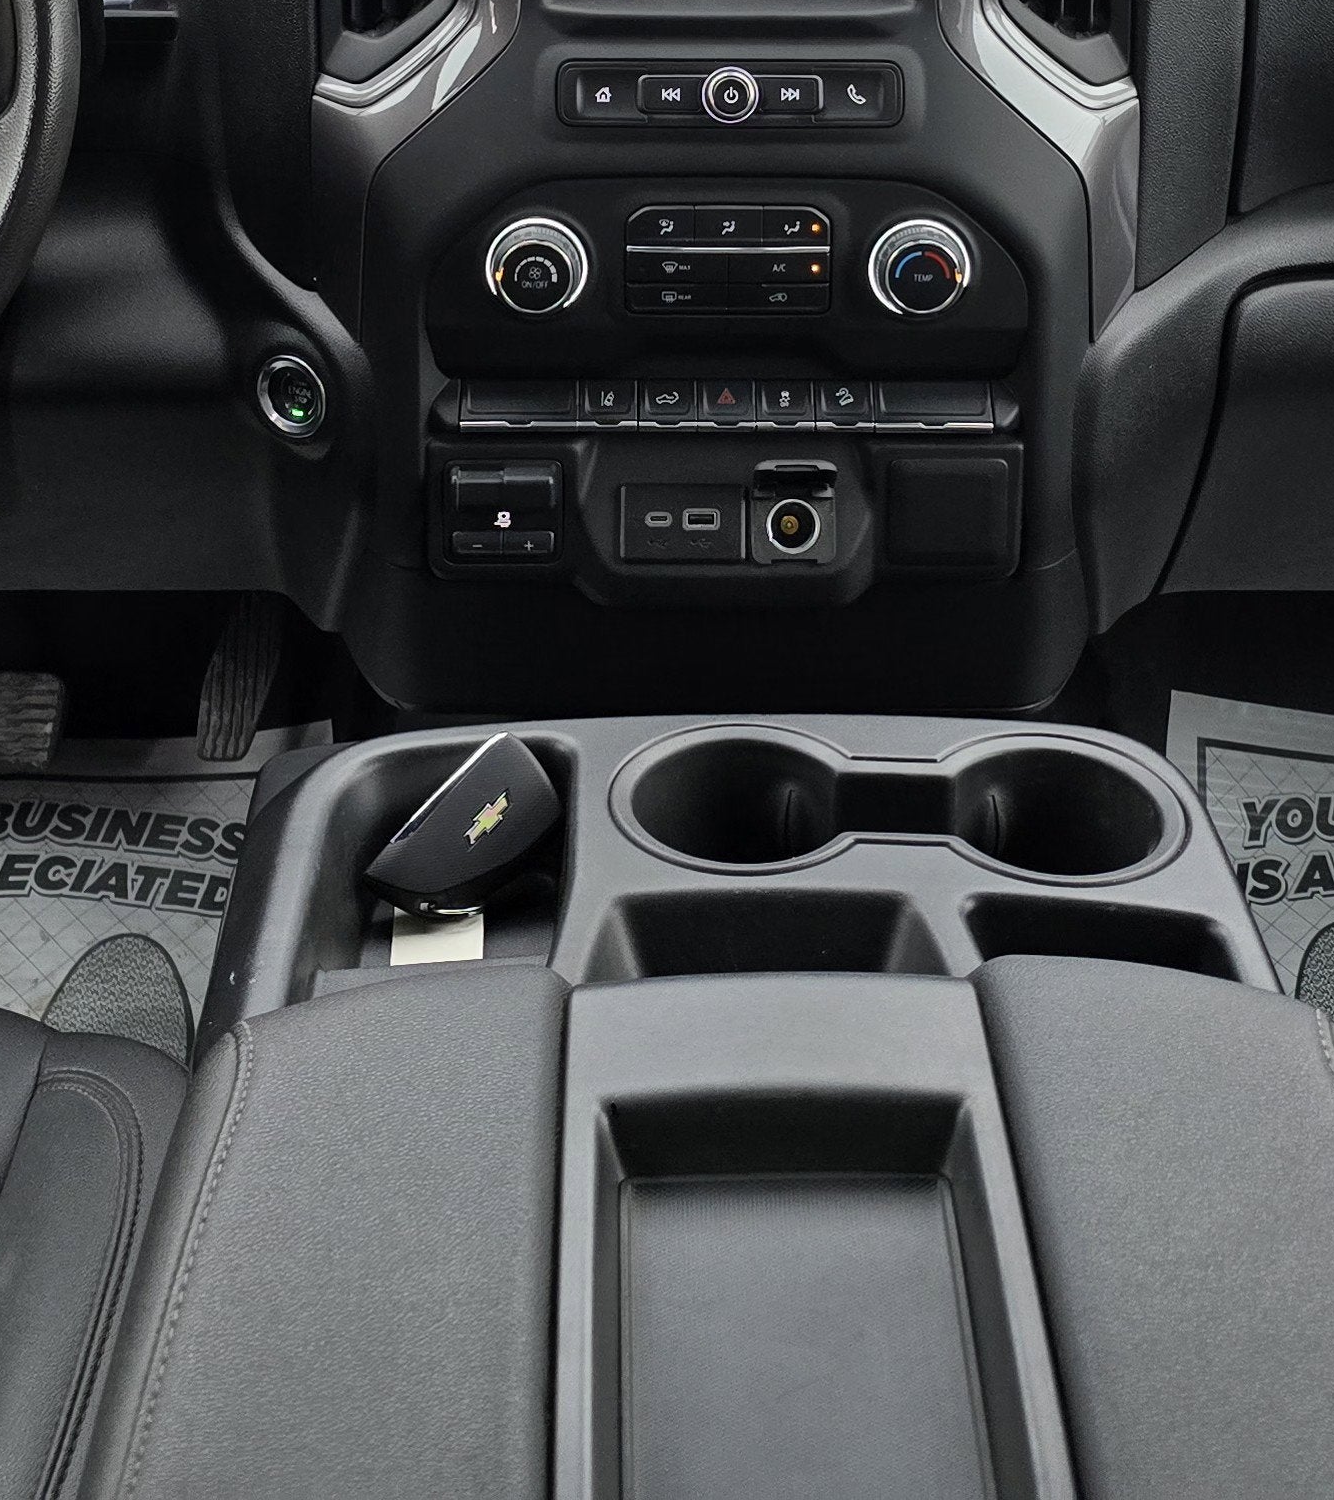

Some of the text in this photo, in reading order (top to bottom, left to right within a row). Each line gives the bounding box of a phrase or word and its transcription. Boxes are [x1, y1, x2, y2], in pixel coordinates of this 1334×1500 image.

[773, 263, 786, 273] A/C
[914, 274, 934, 283] TEMP
[521, 280, 549, 289] ON/OFF
[1235, 858, 1289, 904] IS
